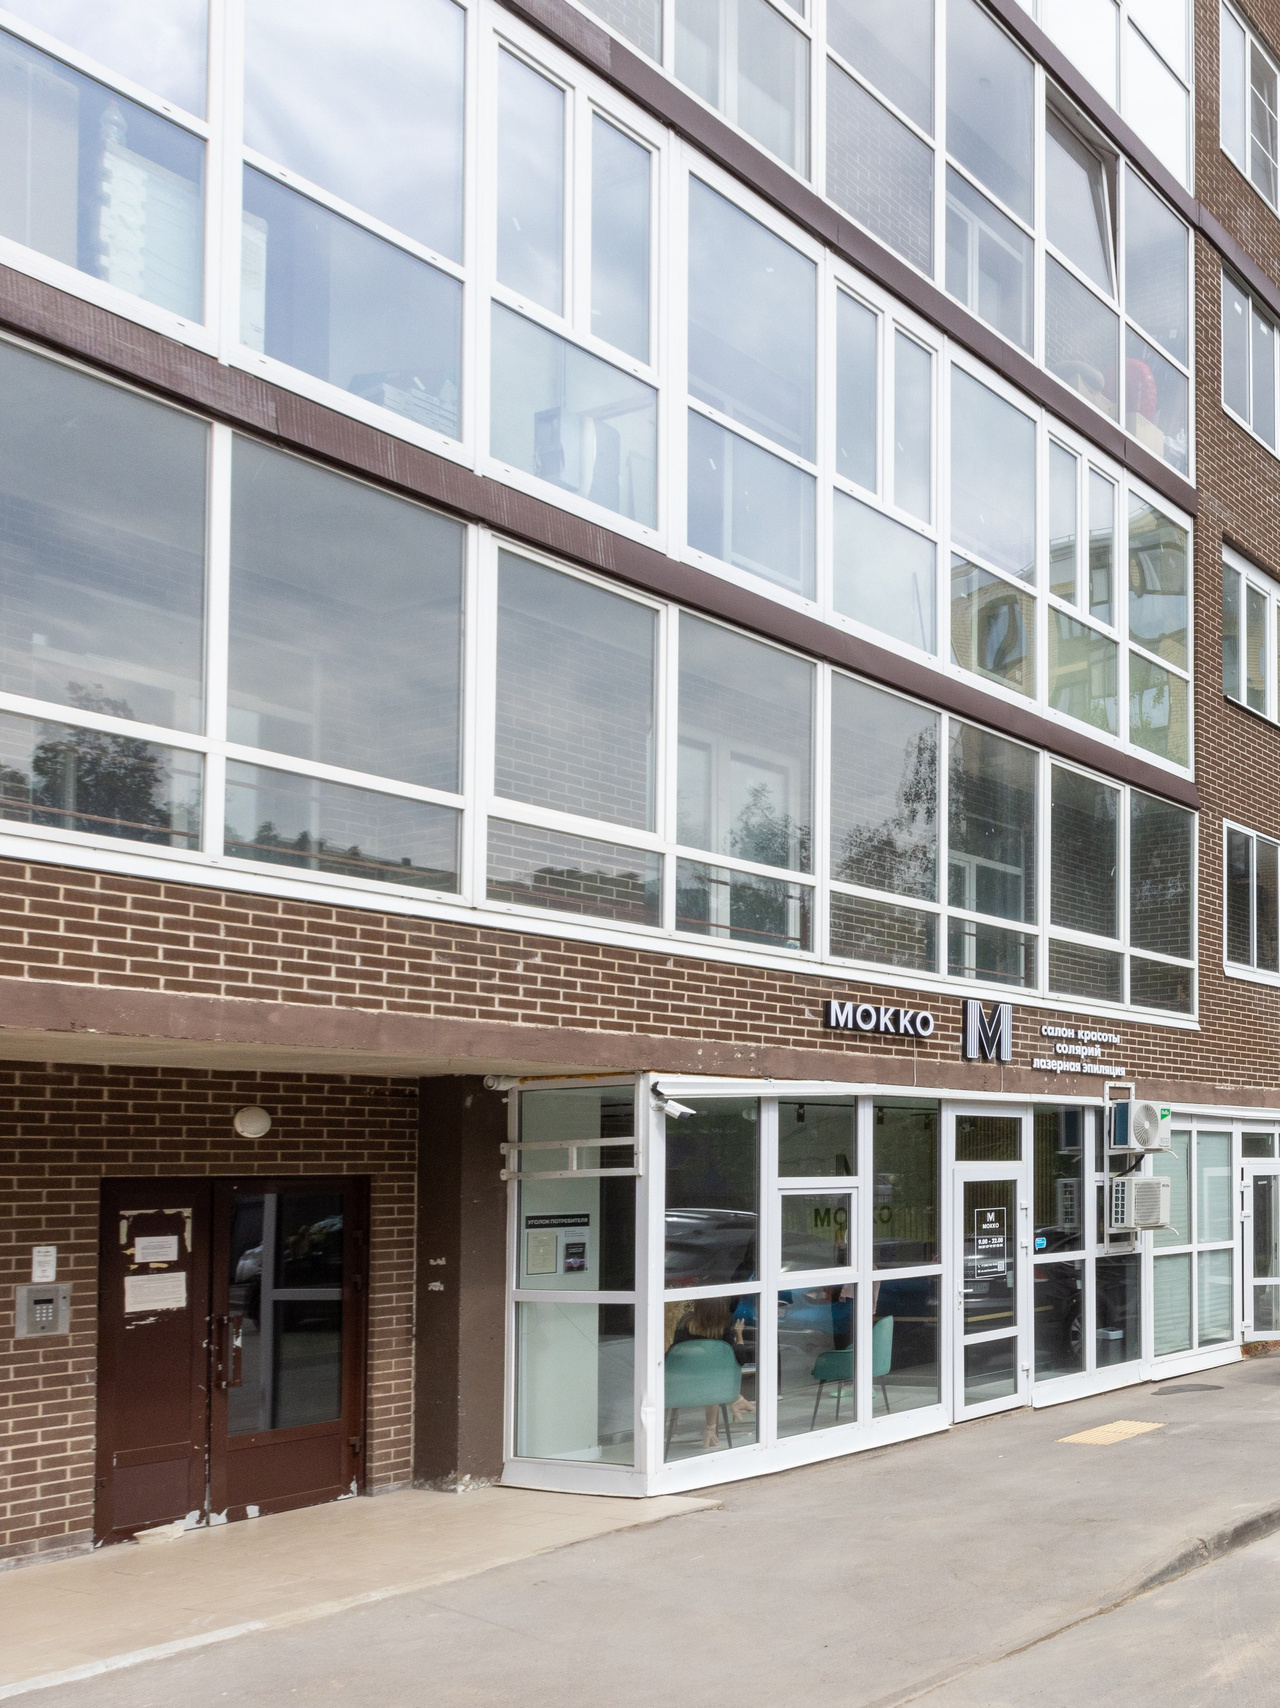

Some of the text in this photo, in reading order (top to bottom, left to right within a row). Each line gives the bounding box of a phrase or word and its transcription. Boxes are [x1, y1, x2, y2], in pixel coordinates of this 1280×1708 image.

[830, 1000, 935, 1037] МОККО
[965, 999, 1012, 1061] М
[1041, 1025, 1120, 1044] салон красоты
[1055, 1043, 1101, 1059] солярий
[1032, 1058, 1126, 1078] лазерная эпиляция
[813, 1205, 893, 1228] МОО
[986, 1212, 995, 1222] М
